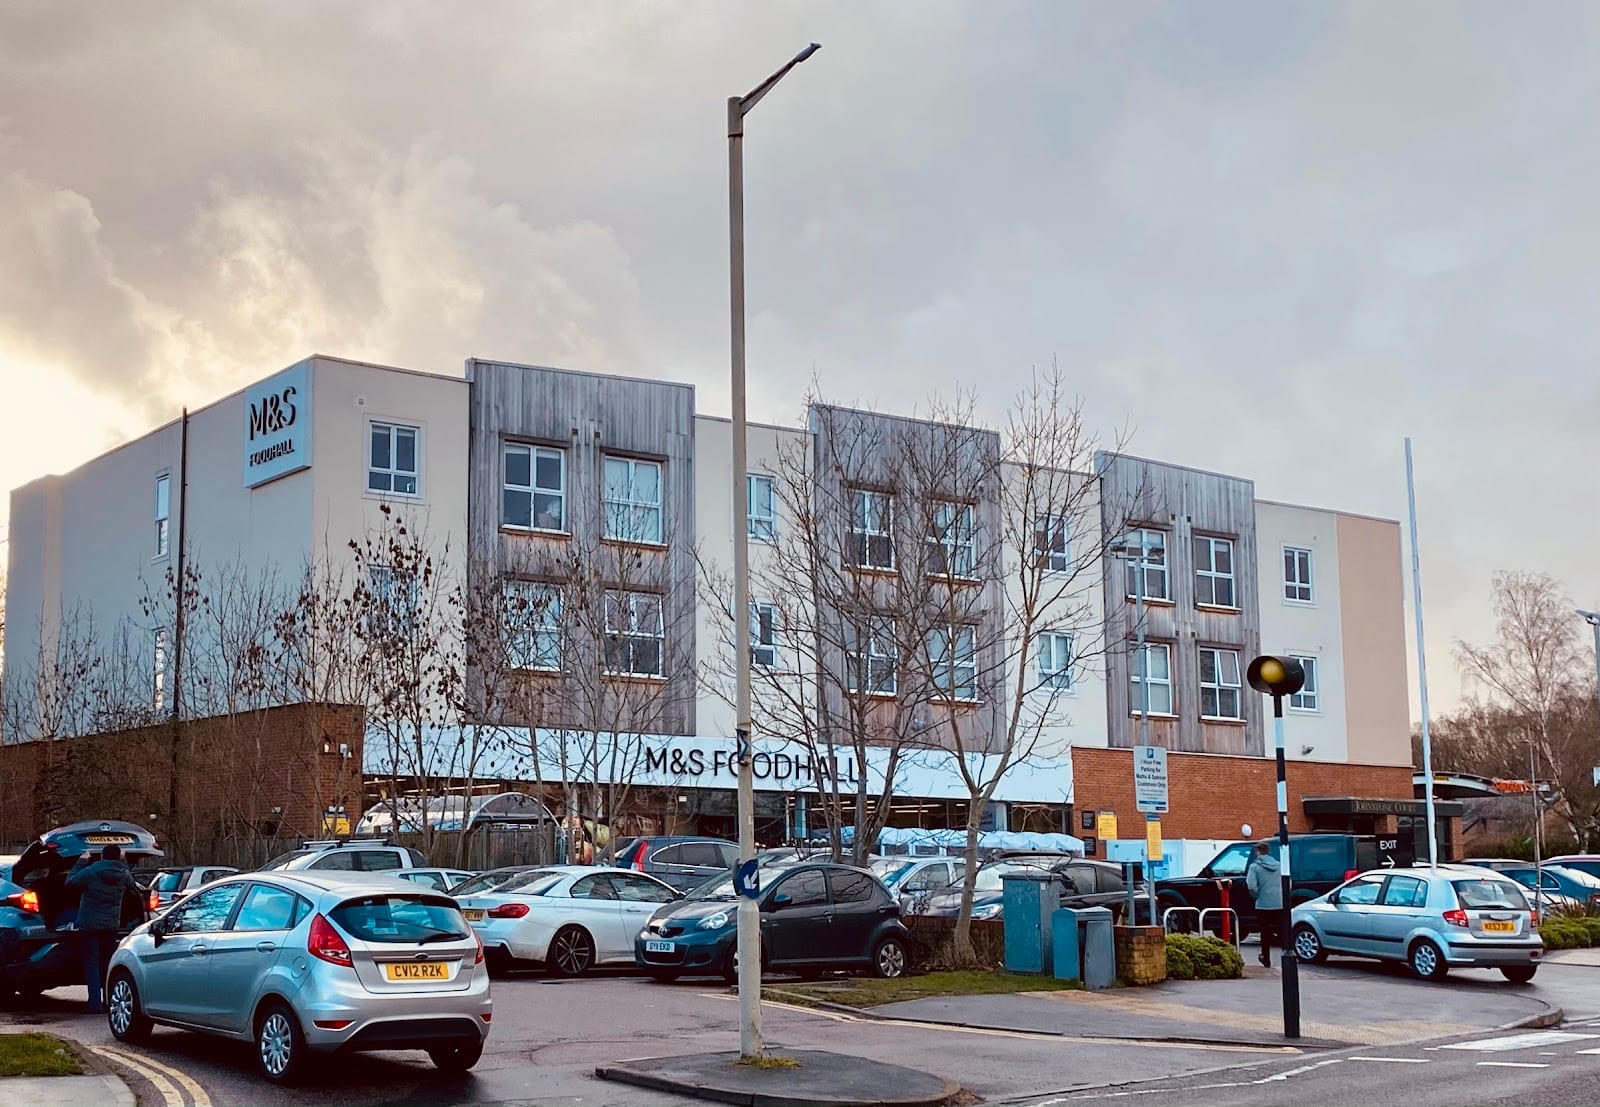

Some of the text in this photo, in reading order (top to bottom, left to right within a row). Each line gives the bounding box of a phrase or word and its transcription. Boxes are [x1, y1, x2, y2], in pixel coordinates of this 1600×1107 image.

[250, 386, 296, 440] M&S
[249, 438, 295, 467] FOODHALL
[646, 746, 704, 776] M&S
[1380, 840, 1397, 850] EXIT
[394, 964, 443, 977] CV12 RZK
